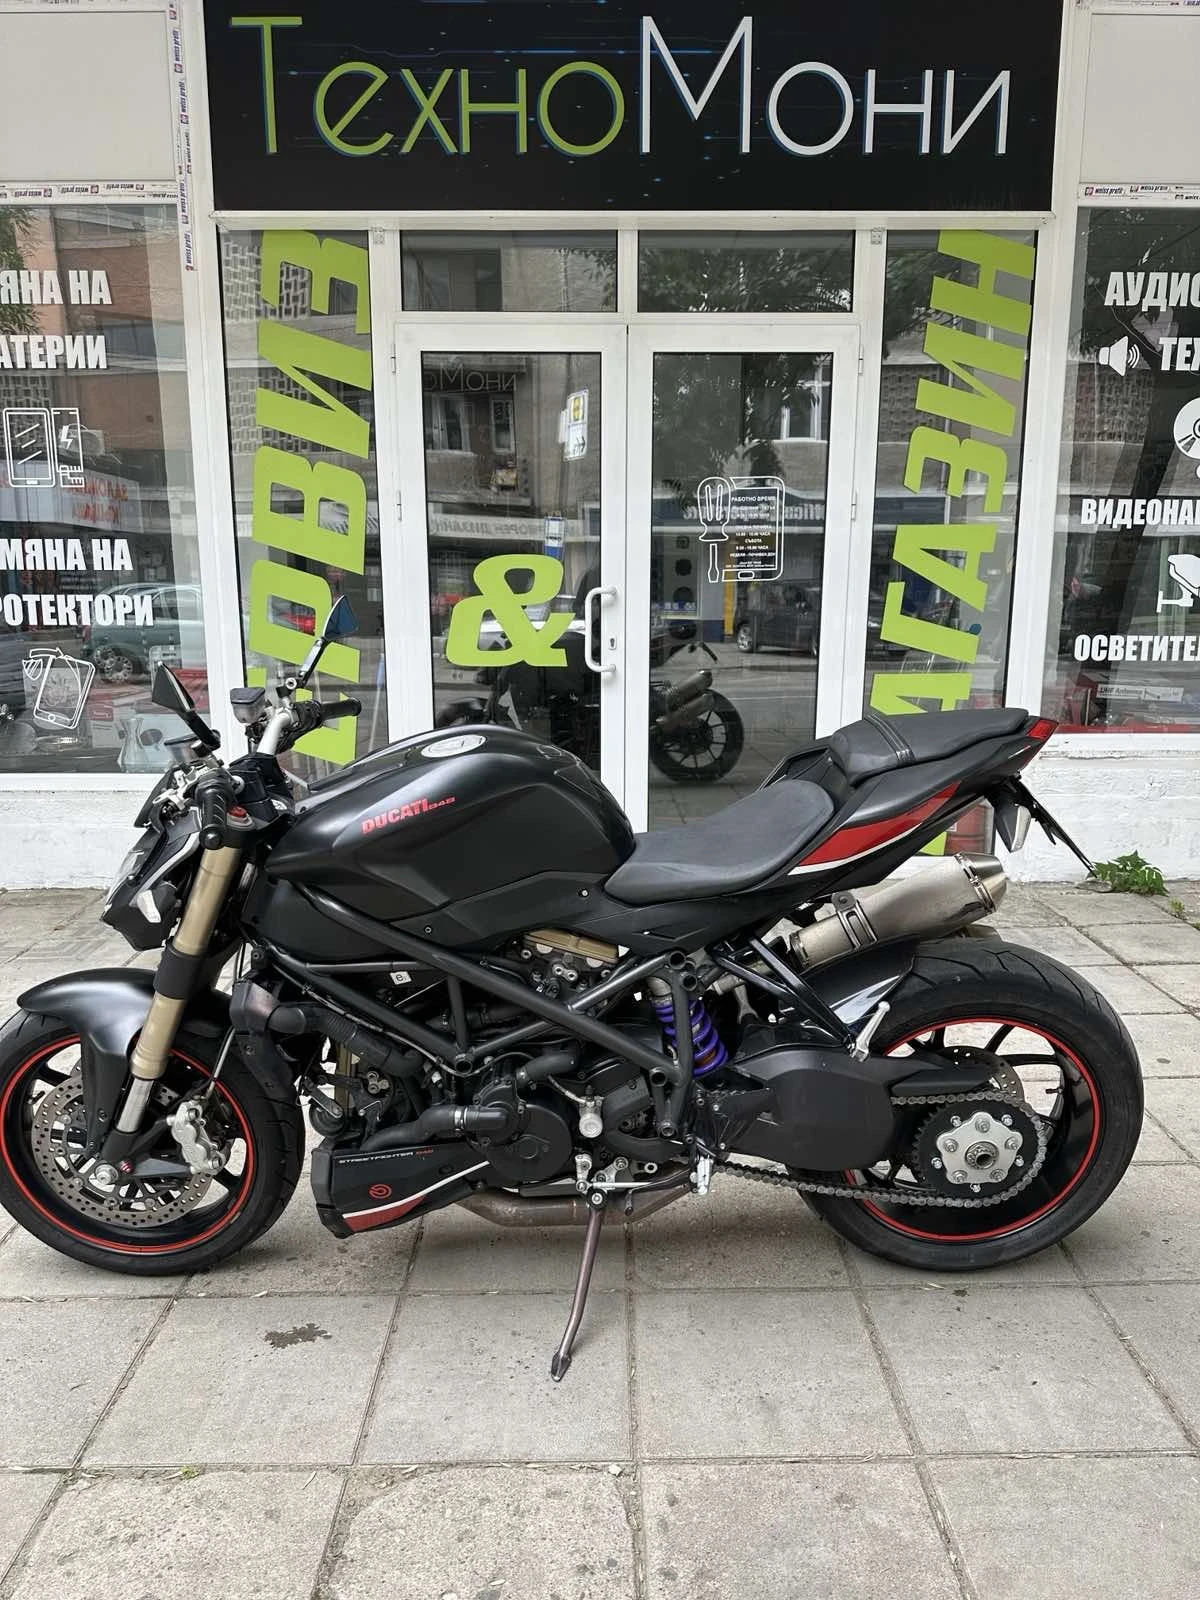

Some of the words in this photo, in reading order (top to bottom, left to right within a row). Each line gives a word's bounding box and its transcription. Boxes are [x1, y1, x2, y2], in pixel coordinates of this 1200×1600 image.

[68, 269, 113, 305] НА
[0, 538, 87, 571] МЯНА
[91, 538, 134, 571] НА
[0, 593, 154, 627] ОТЕКТОРИ
[445, 553, 576, 668] &
[1073, 634, 1200, 662] ОСВЕТИТЕ
[362, 798, 429, 834] DUCATI
